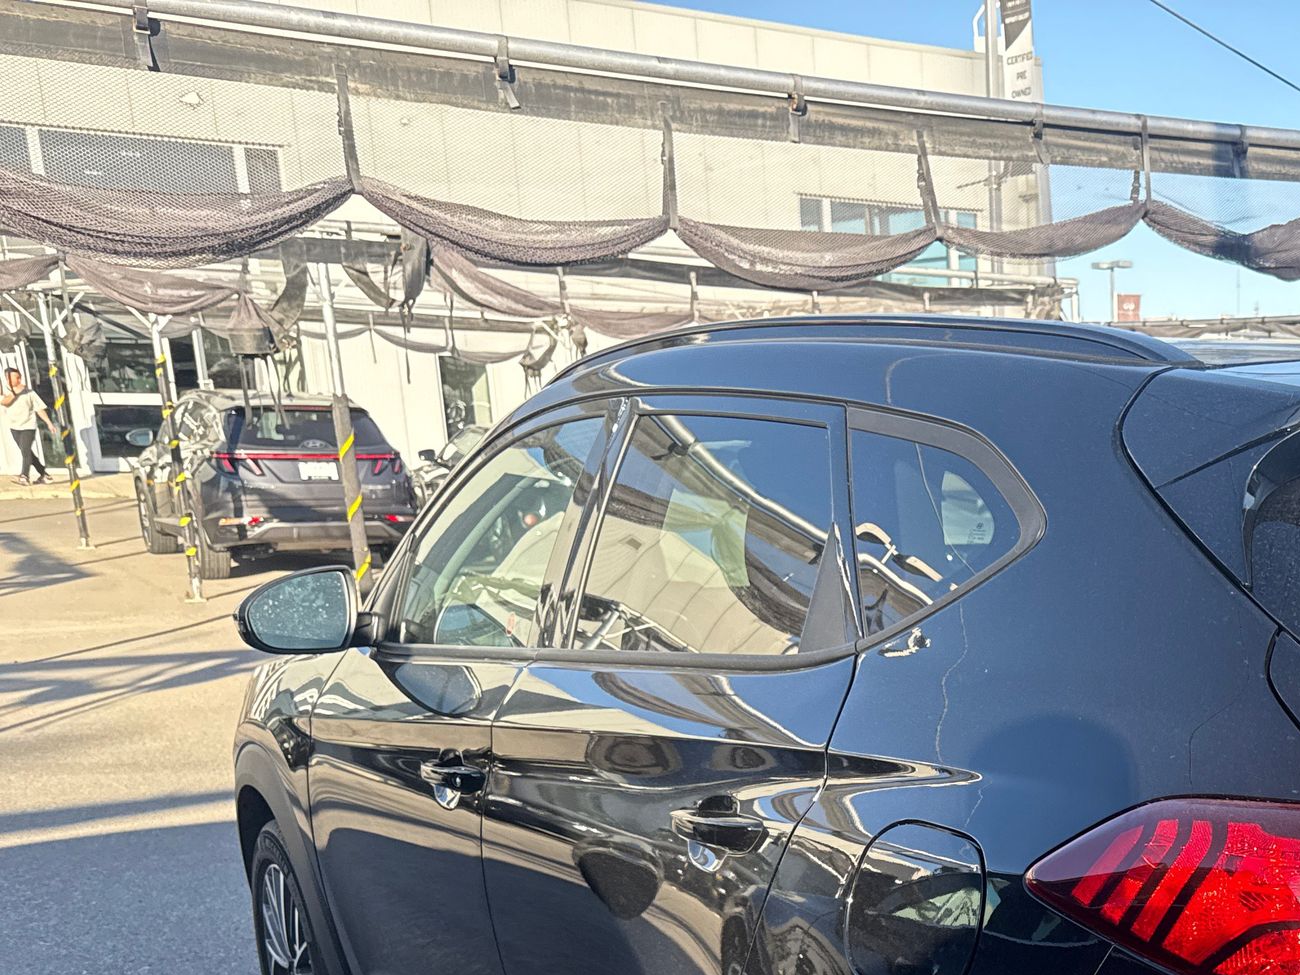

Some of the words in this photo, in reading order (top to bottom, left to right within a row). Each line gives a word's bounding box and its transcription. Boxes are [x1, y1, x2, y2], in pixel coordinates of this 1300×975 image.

[1006, 51, 1033, 65] CERTIFIED
[1016, 70, 1028, 80] PRE
[1011, 86, 1032, 98] OWNED
